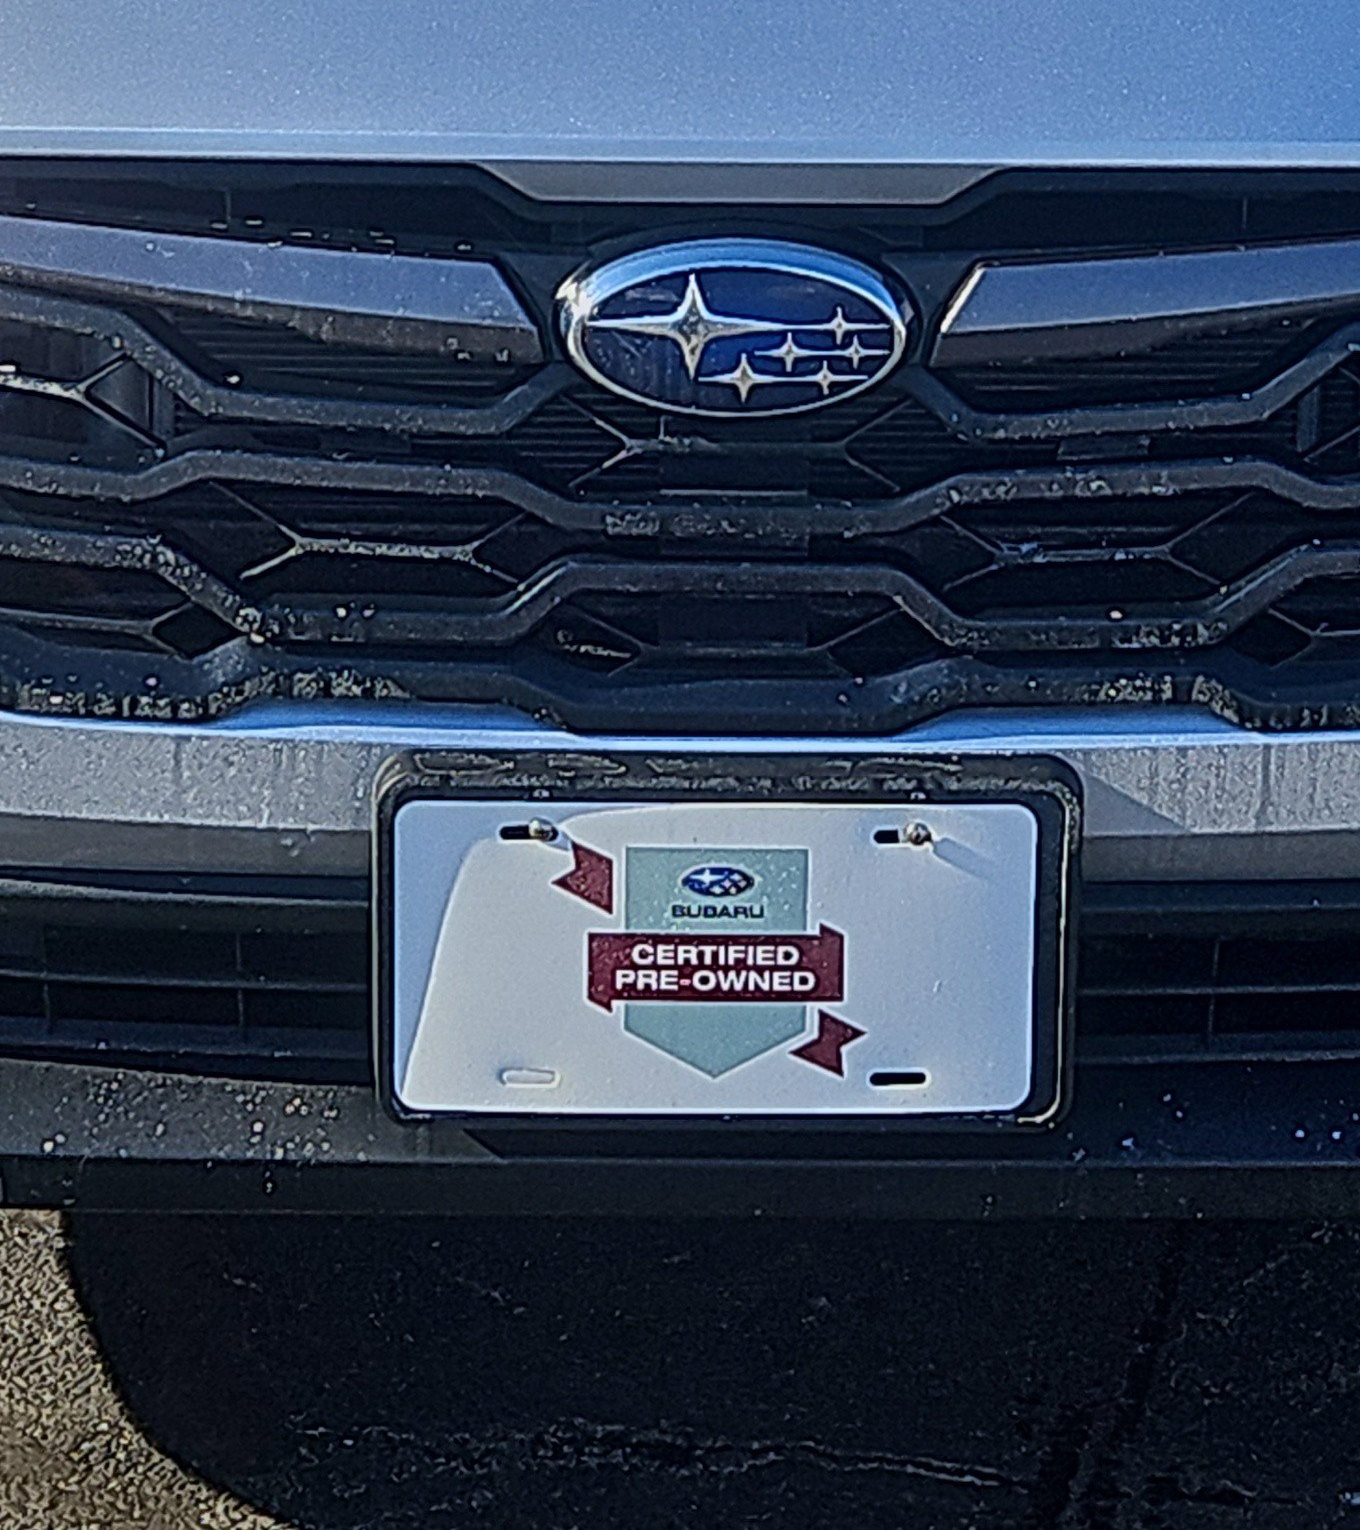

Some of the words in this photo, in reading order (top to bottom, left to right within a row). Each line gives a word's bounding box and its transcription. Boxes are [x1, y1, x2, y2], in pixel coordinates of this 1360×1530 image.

[671, 904, 765, 919] SUBARU
[631, 943, 800, 966] CERTIFIED
[615, 969, 816, 992] PRE-OWNED
